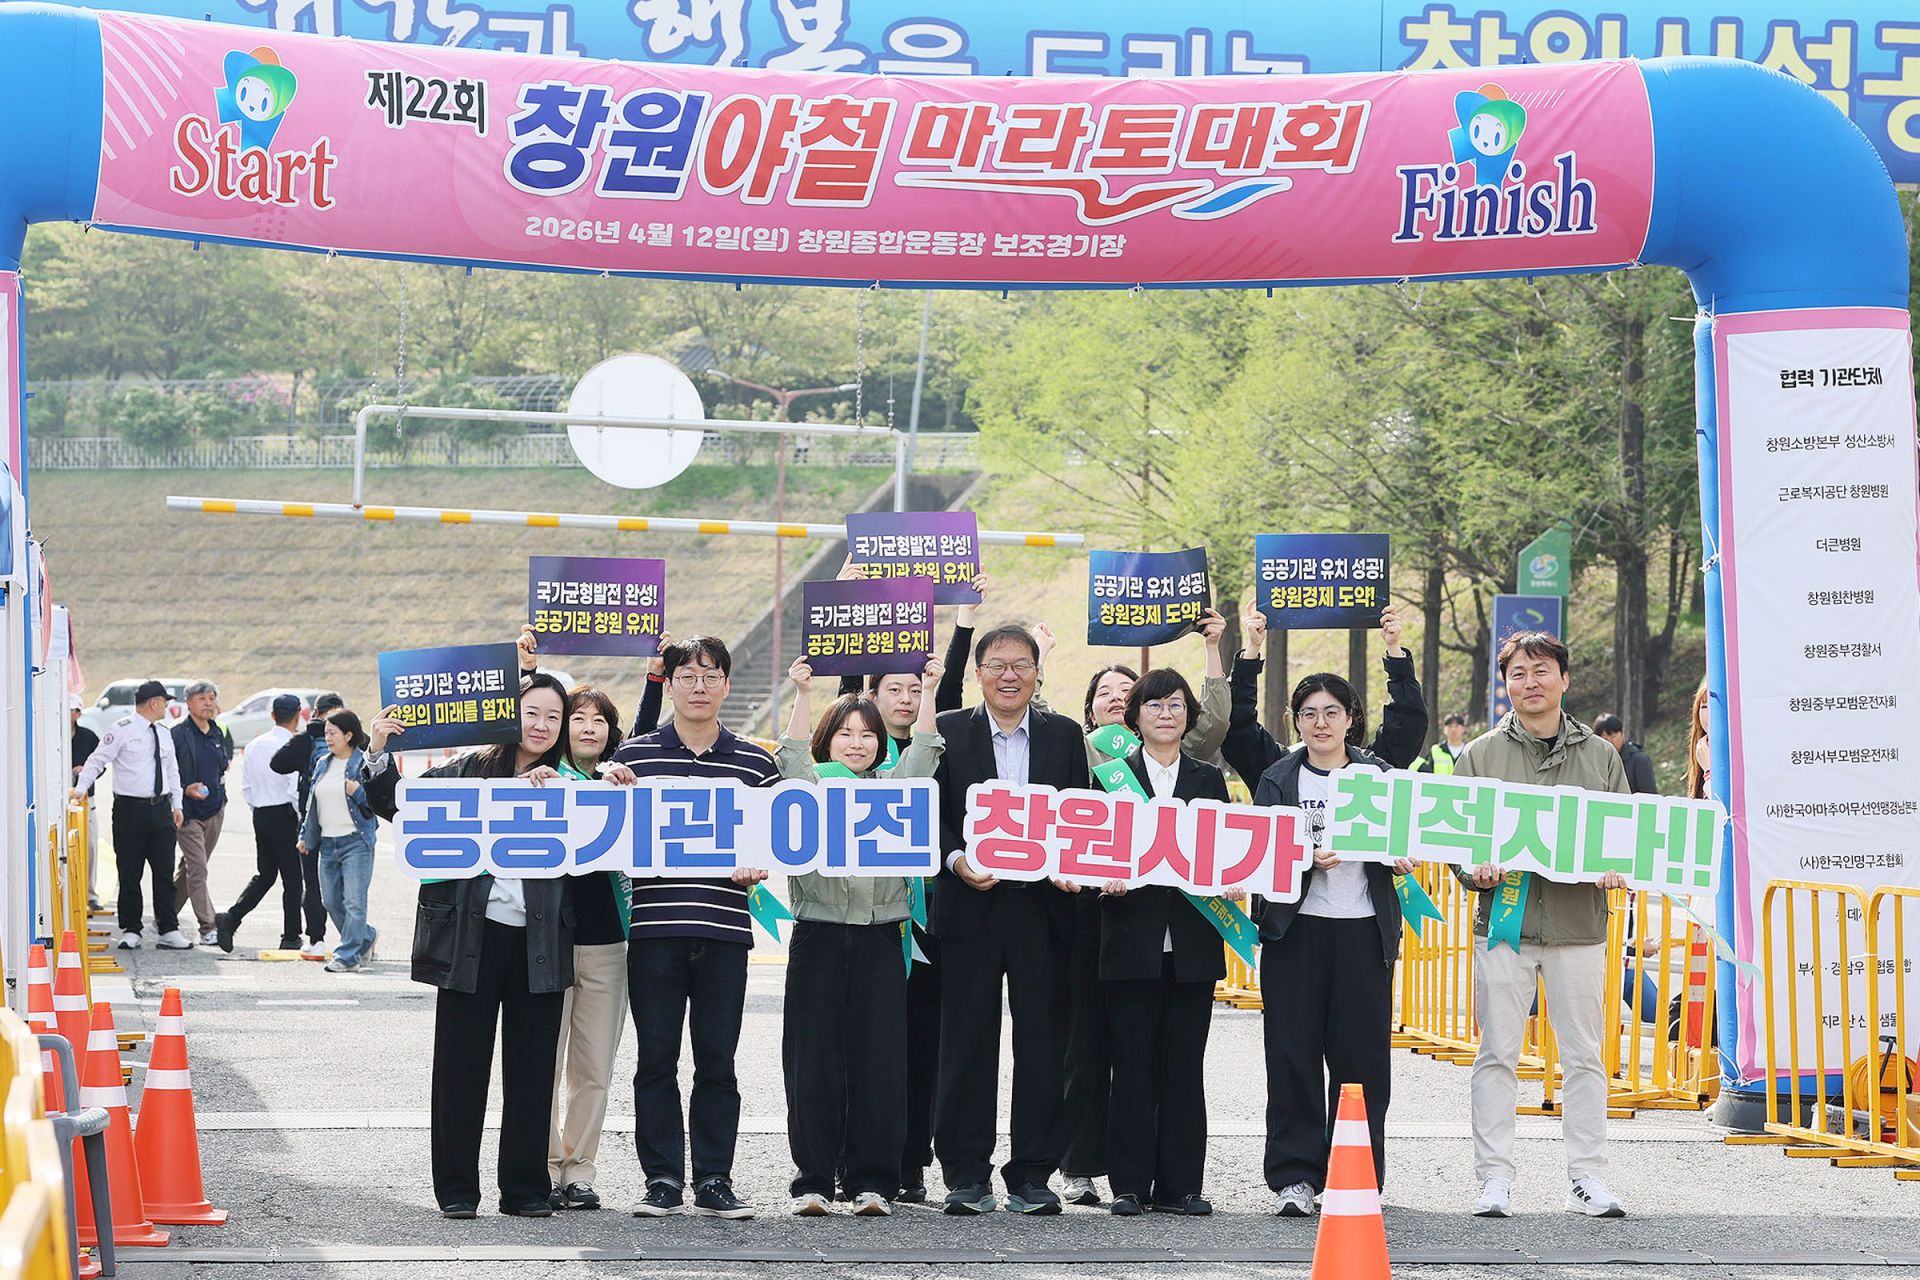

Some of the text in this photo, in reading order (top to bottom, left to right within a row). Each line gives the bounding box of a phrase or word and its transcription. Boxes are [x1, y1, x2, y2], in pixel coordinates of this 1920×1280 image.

[367, 71, 486, 133] 제22회
[509, 84, 893, 201] 창원야철
[173, 117, 335, 208] Start
[1396, 153, 1597, 241] Finish
[525, 216, 1127, 258] 2026년 4월 12일(일) 창원종합운동장 보조경기장
[1780, 367, 1883, 388] 협력 기관단체
[1766, 433, 1895, 453] 창원소방본부 성산소방서
[1778, 484, 1889, 502] 근로복지공단 창원병원
[855, 534, 973, 557] 국가균형발전 완성!
[1816, 537, 1861, 552] 더큰병원
[944, 561, 977, 584] 유치!
[1261, 557, 1385, 581] 공공기관 유치 성공!
[536, 581, 659, 607] 국가균형발전 완성!
[1093, 571, 1207, 598] 공공기관 유치 성공!
[1270, 586, 1376, 608] 창원경제 도약!
[1807, 589, 1875, 606] 창원힘찬병원
[534, 609, 660, 636] 공공기관 창원 유치!
[810, 601, 928, 628] 국가균형발전 완성!
[1100, 601, 1201, 626] 창원경제 도약!
[807, 630, 930, 657] 공공기관 창원 유치!
[1804, 642, 1882, 659] 창원중부경찰서
[394, 669, 505, 699] 공공기관 유치로!
[435, 700, 479, 725] 미래를
[482, 697, 516, 722] 열자!
[1789, 695, 1897, 712] 창원중부모범운전자회
[1790, 747, 1899, 765] 창원서부모범운전자회
[402, 786, 932, 869] 공공기관 이전
[1331, 772, 1716, 887] 최적지다!!
[973, 788, 1304, 893] 창원시가
[1799, 853, 1904, 870] (사)한국인명구조협회
